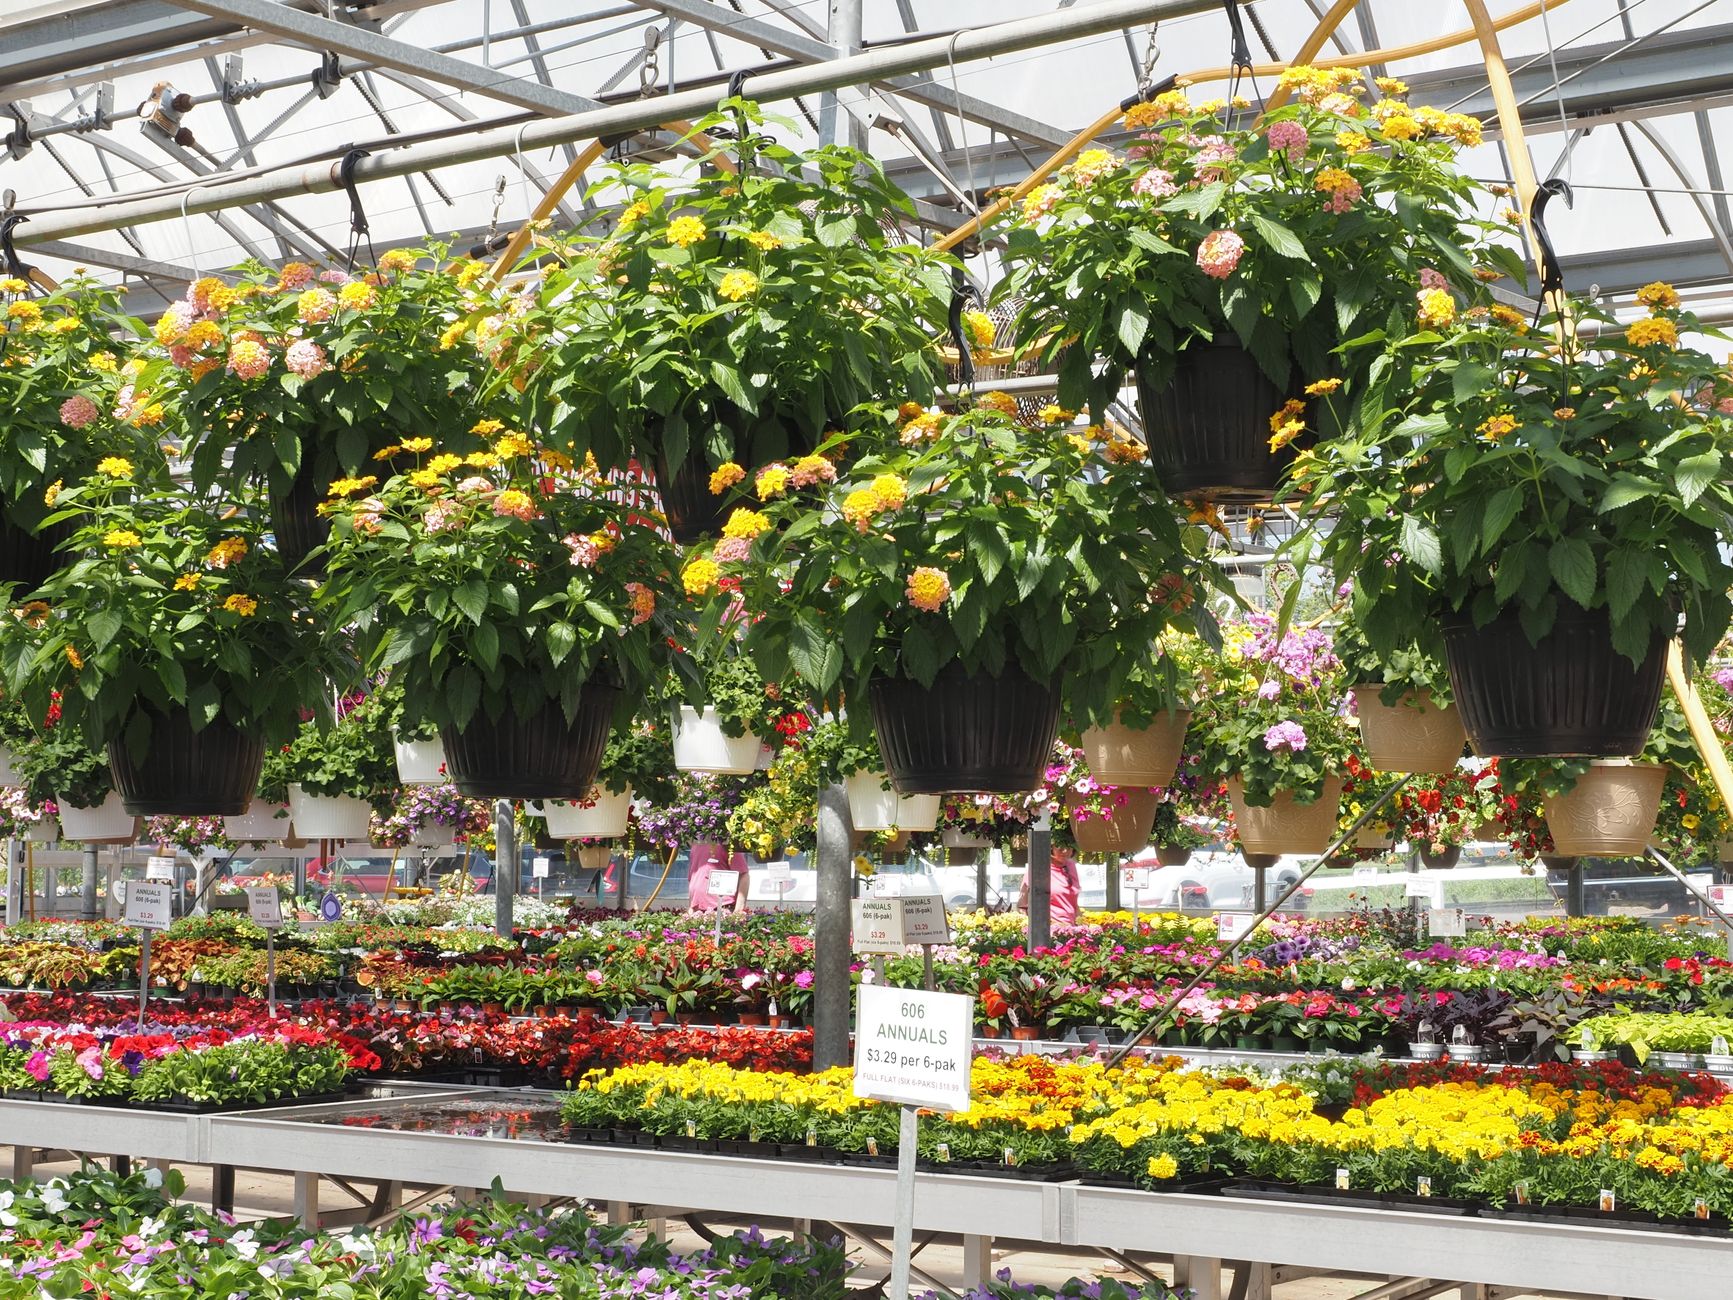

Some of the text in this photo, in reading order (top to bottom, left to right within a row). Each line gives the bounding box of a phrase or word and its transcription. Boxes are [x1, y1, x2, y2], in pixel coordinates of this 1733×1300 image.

[873, 912, 893, 920] (6-pak)
[871, 931, 886, 939] $3.29
[901, 1002, 925, 1019] 606
[876, 1023, 948, 1046] ANNUALS
[867, 1048, 956, 1072] $3.29 per 6-pak
[862, 1073, 878, 1082] FULL
[880, 1074, 897, 1083] FLAT
[898, 1076, 911, 1086] (SIX
[911, 1078, 938, 1090] 6-PAKS)
